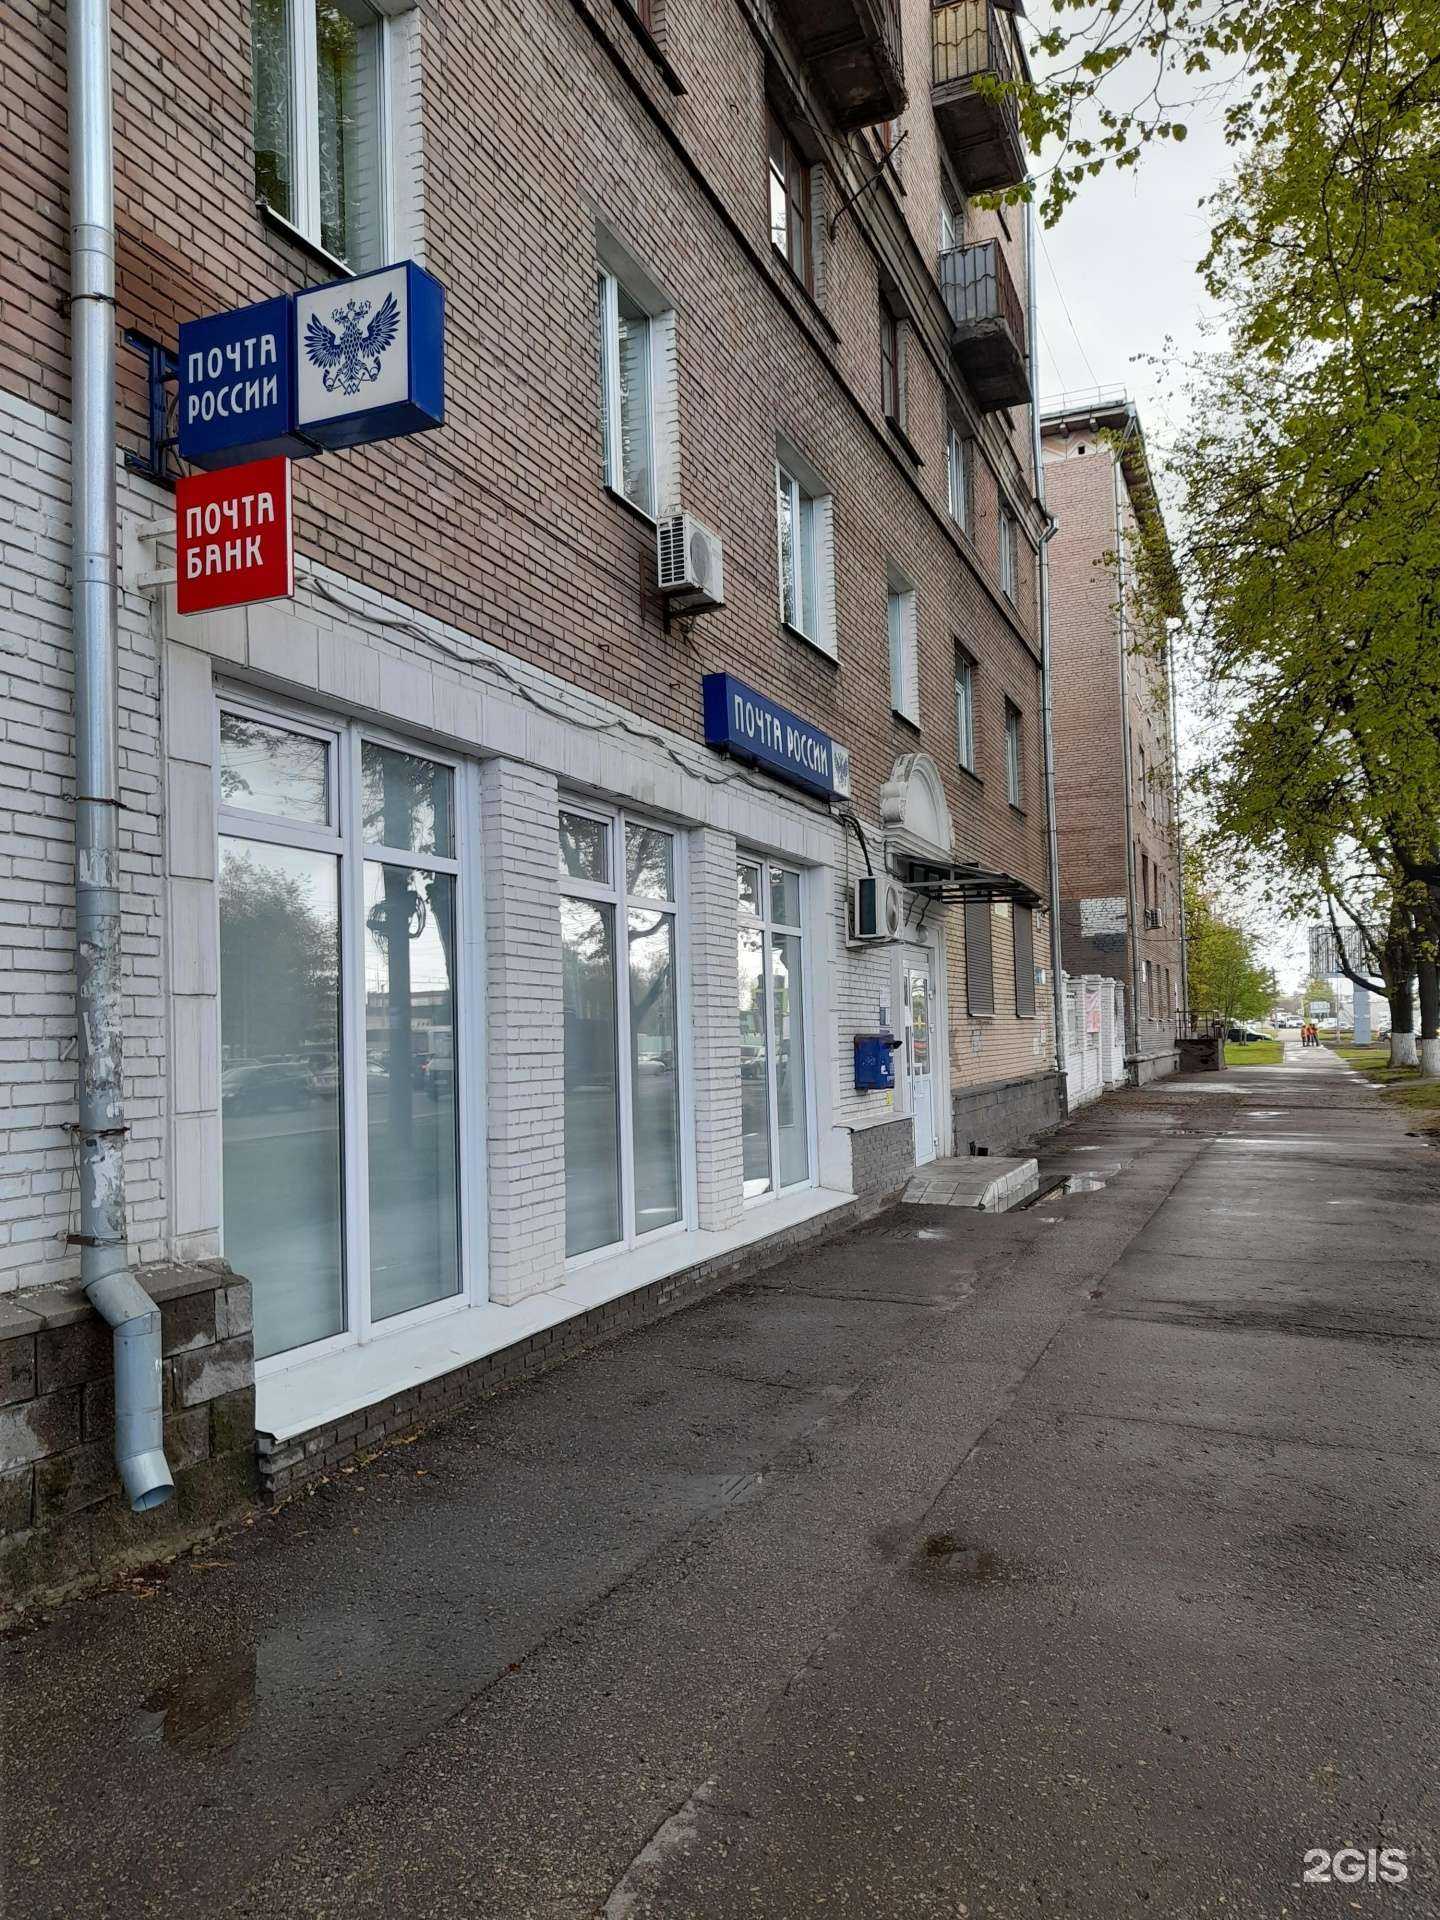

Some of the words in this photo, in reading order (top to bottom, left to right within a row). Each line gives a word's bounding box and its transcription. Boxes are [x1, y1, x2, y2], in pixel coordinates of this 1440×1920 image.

[188, 333, 277, 384] ПОЧТА
[188, 374, 278, 424] РОССИИ
[186, 492, 275, 539] ПОЧТА
[187, 535, 264, 579] БАНК
[734, 694, 783, 754] ПОЧТА
[787, 725, 829, 777] РОССИИ
